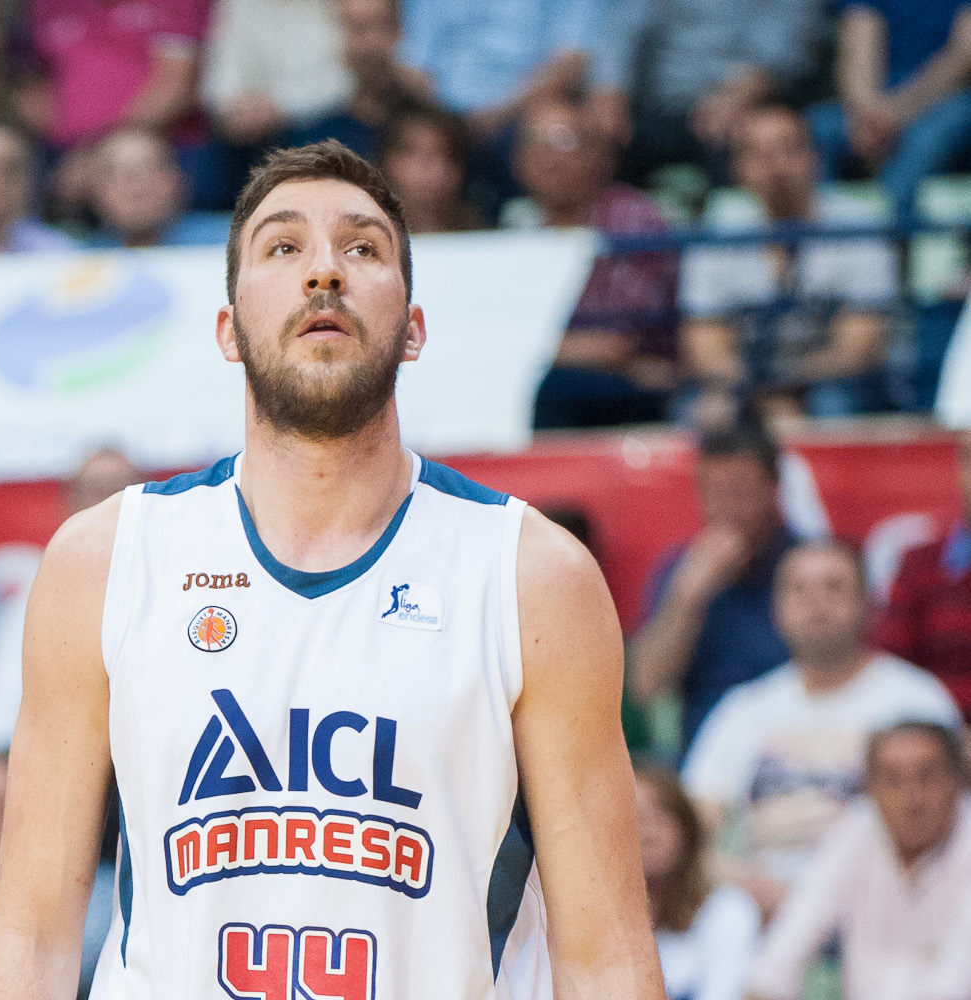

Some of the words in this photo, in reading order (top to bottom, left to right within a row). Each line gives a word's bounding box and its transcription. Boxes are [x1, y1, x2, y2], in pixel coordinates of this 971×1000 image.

[398, 612, 438, 625] endesa
[400, 594, 421, 613] liga
[177, 688, 424, 811] AICL
[169, 811, 430, 890] MANRESA
